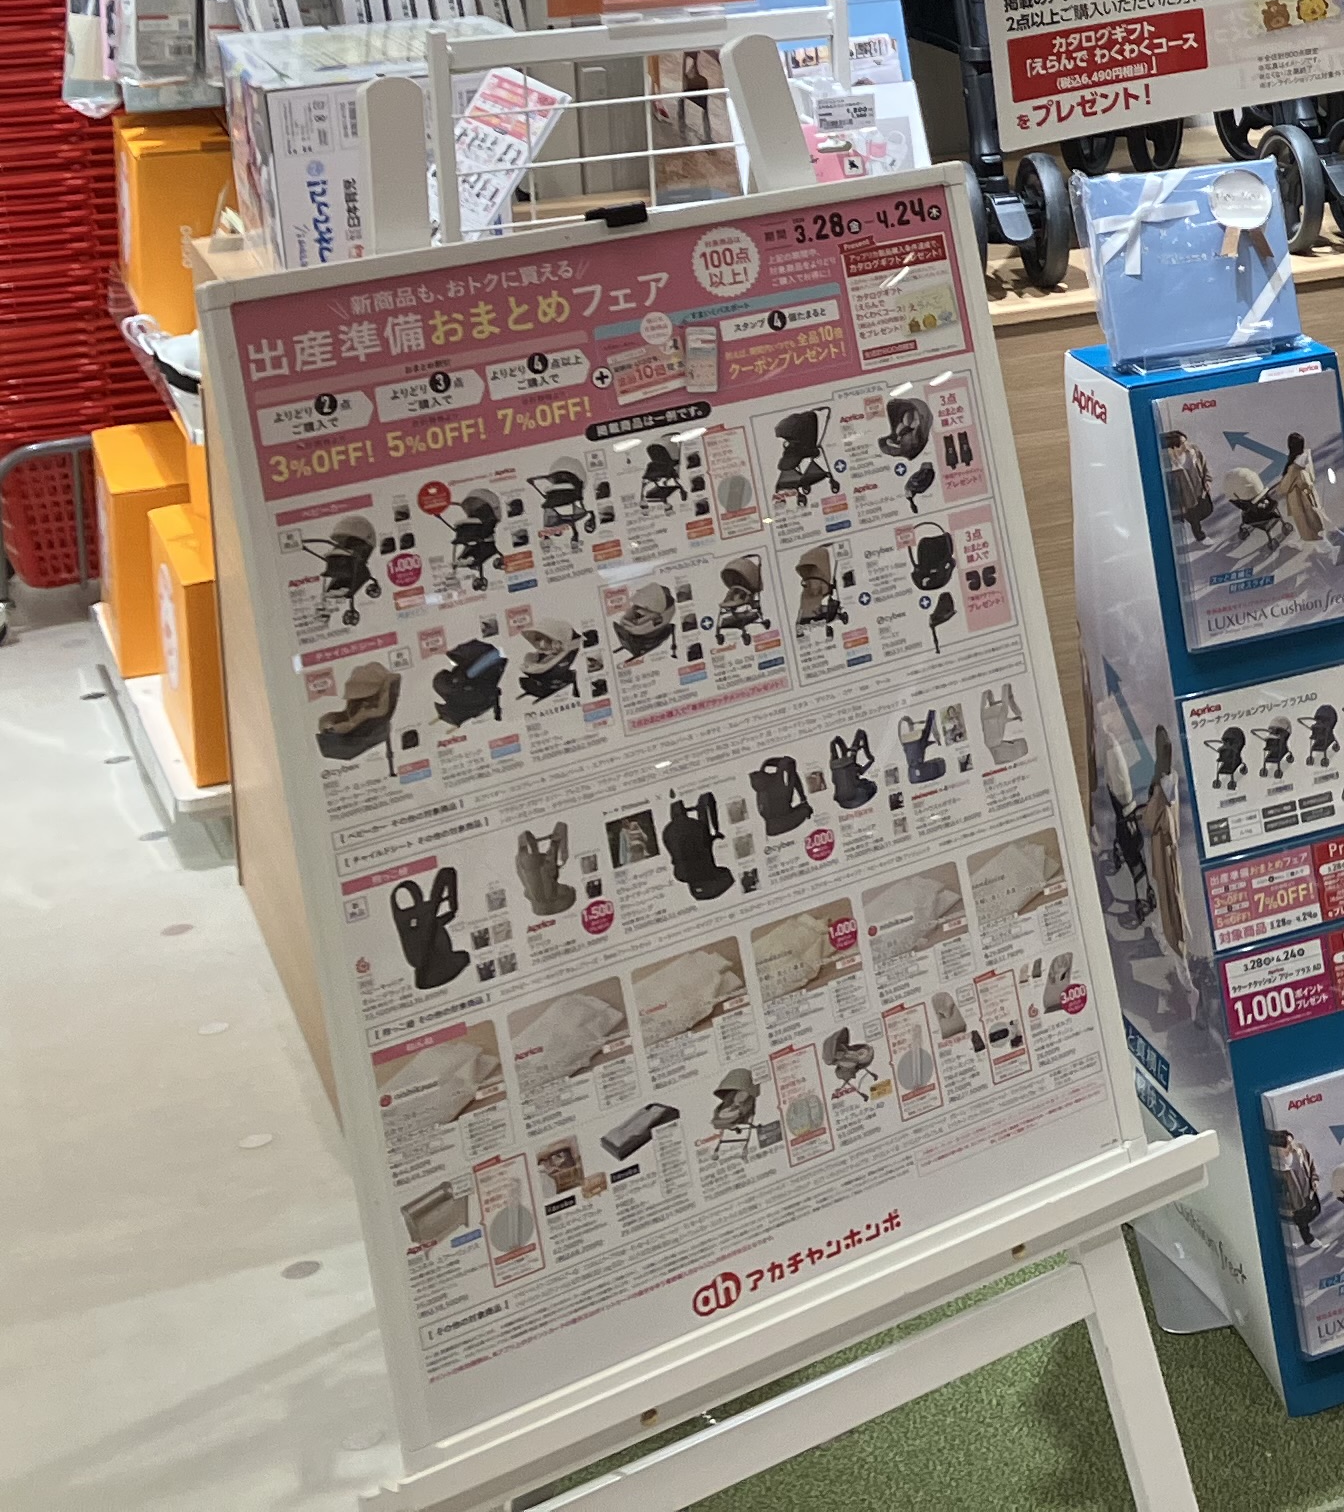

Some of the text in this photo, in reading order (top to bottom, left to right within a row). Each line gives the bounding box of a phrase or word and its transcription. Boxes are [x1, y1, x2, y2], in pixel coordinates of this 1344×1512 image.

[1051, 22, 1156, 54] カタログギフト
[1094, 33, 1199, 67] わくわくコース
[1015, 84, 1153, 130] をプレゼント!
[700, 247, 752, 271] 100点
[351, 259, 574, 316] 新商品も、おトクに買える
[708, 266, 749, 288] 以上!
[247, 271, 670, 383] 出産準備おまとめフェア
[730, 341, 847, 380] クーポンプレゼント!
[517, 373, 561, 391] ご購入で
[407, 395, 454, 413] ご購入で
[497, 396, 592, 435] 7%OFF!
[1071, 383, 1108, 425] Aprica
[1181, 397, 1217, 414] Aprica
[291, 417, 340, 436] ご購入で
[386, 418, 487, 459] 5%OFF!
[269, 440, 376, 483] 3%OFF!
[1207, 606, 1267, 633] LUXUNA
[1270, 596, 1325, 621] Cushion
[1189, 703, 1222, 719] Aprica
[1253, 882, 1315, 913] 7%OFF!
[1233, 987, 1296, 1028] 1,000
[1287, 1091, 1323, 1112] Aprica
[746, 1208, 902, 1292] アカチャンホンポ
